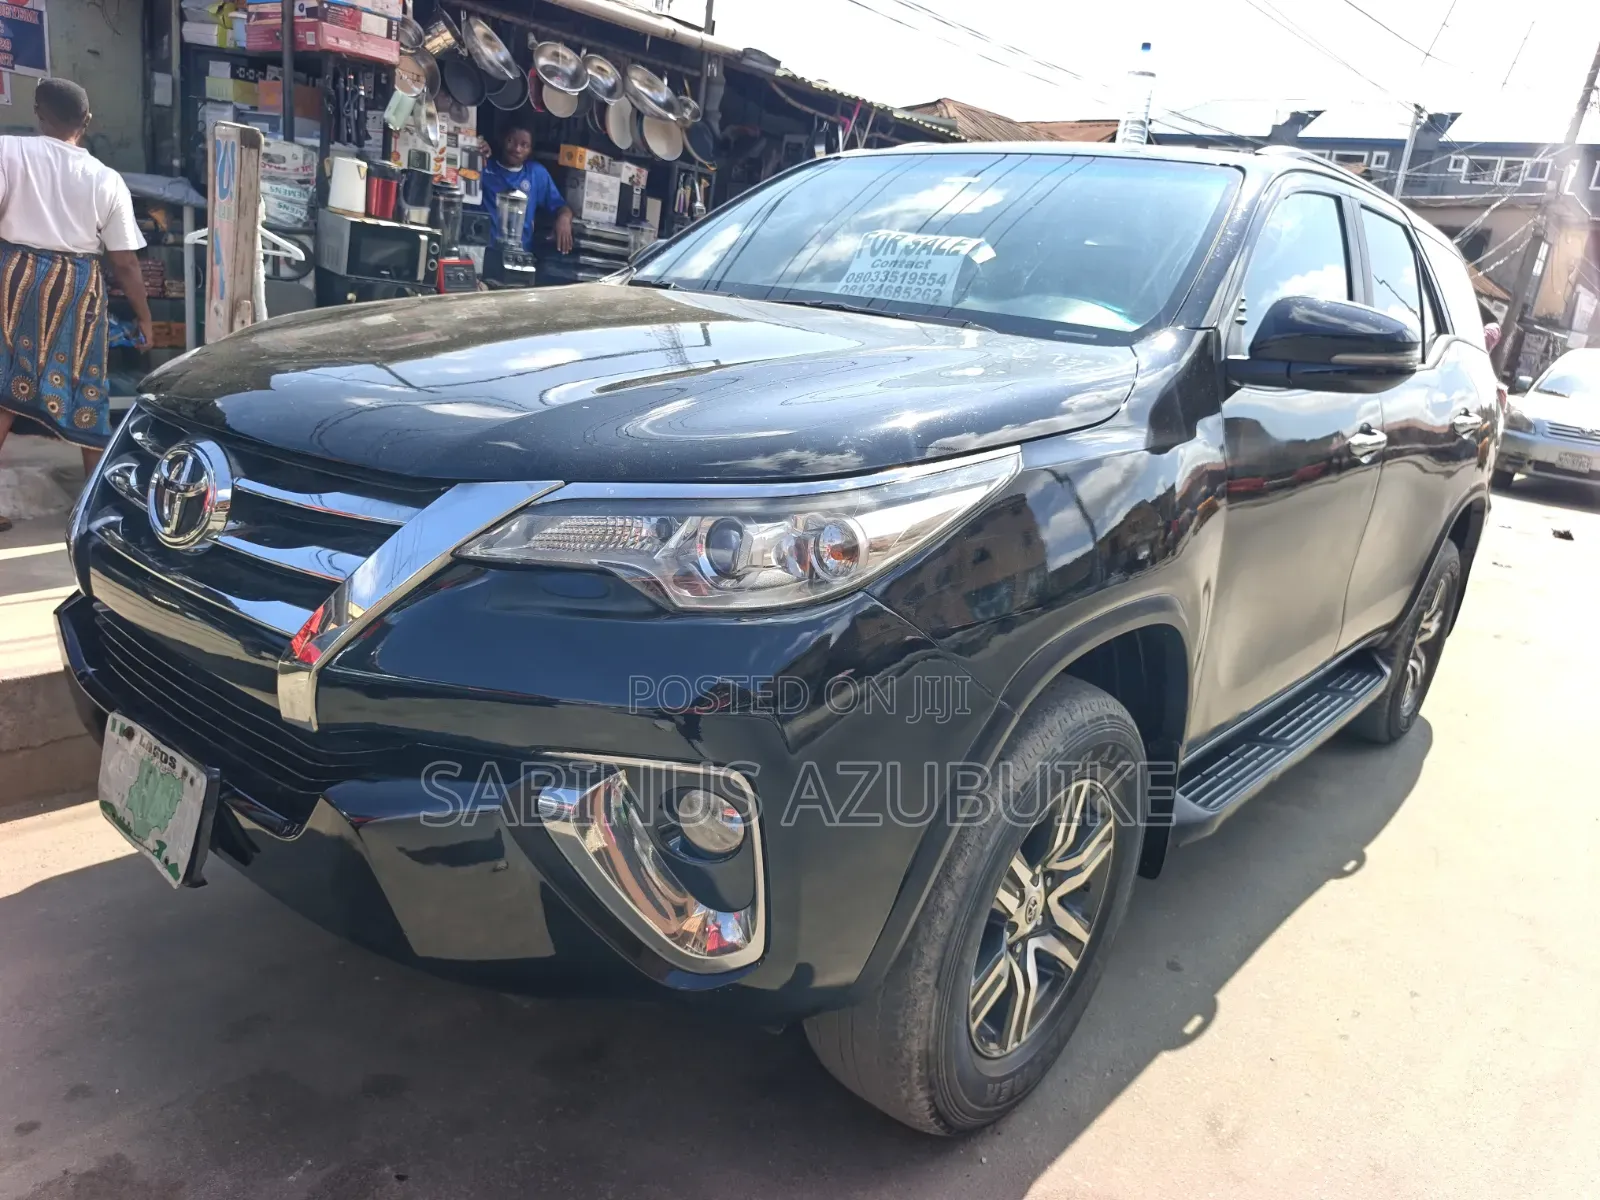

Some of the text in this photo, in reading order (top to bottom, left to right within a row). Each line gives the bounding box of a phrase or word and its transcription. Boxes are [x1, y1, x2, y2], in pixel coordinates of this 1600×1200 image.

[856, 231, 972, 259] FOR SALE
[870, 258, 932, 269] Contact
[845, 270, 948, 286] 08033519554
